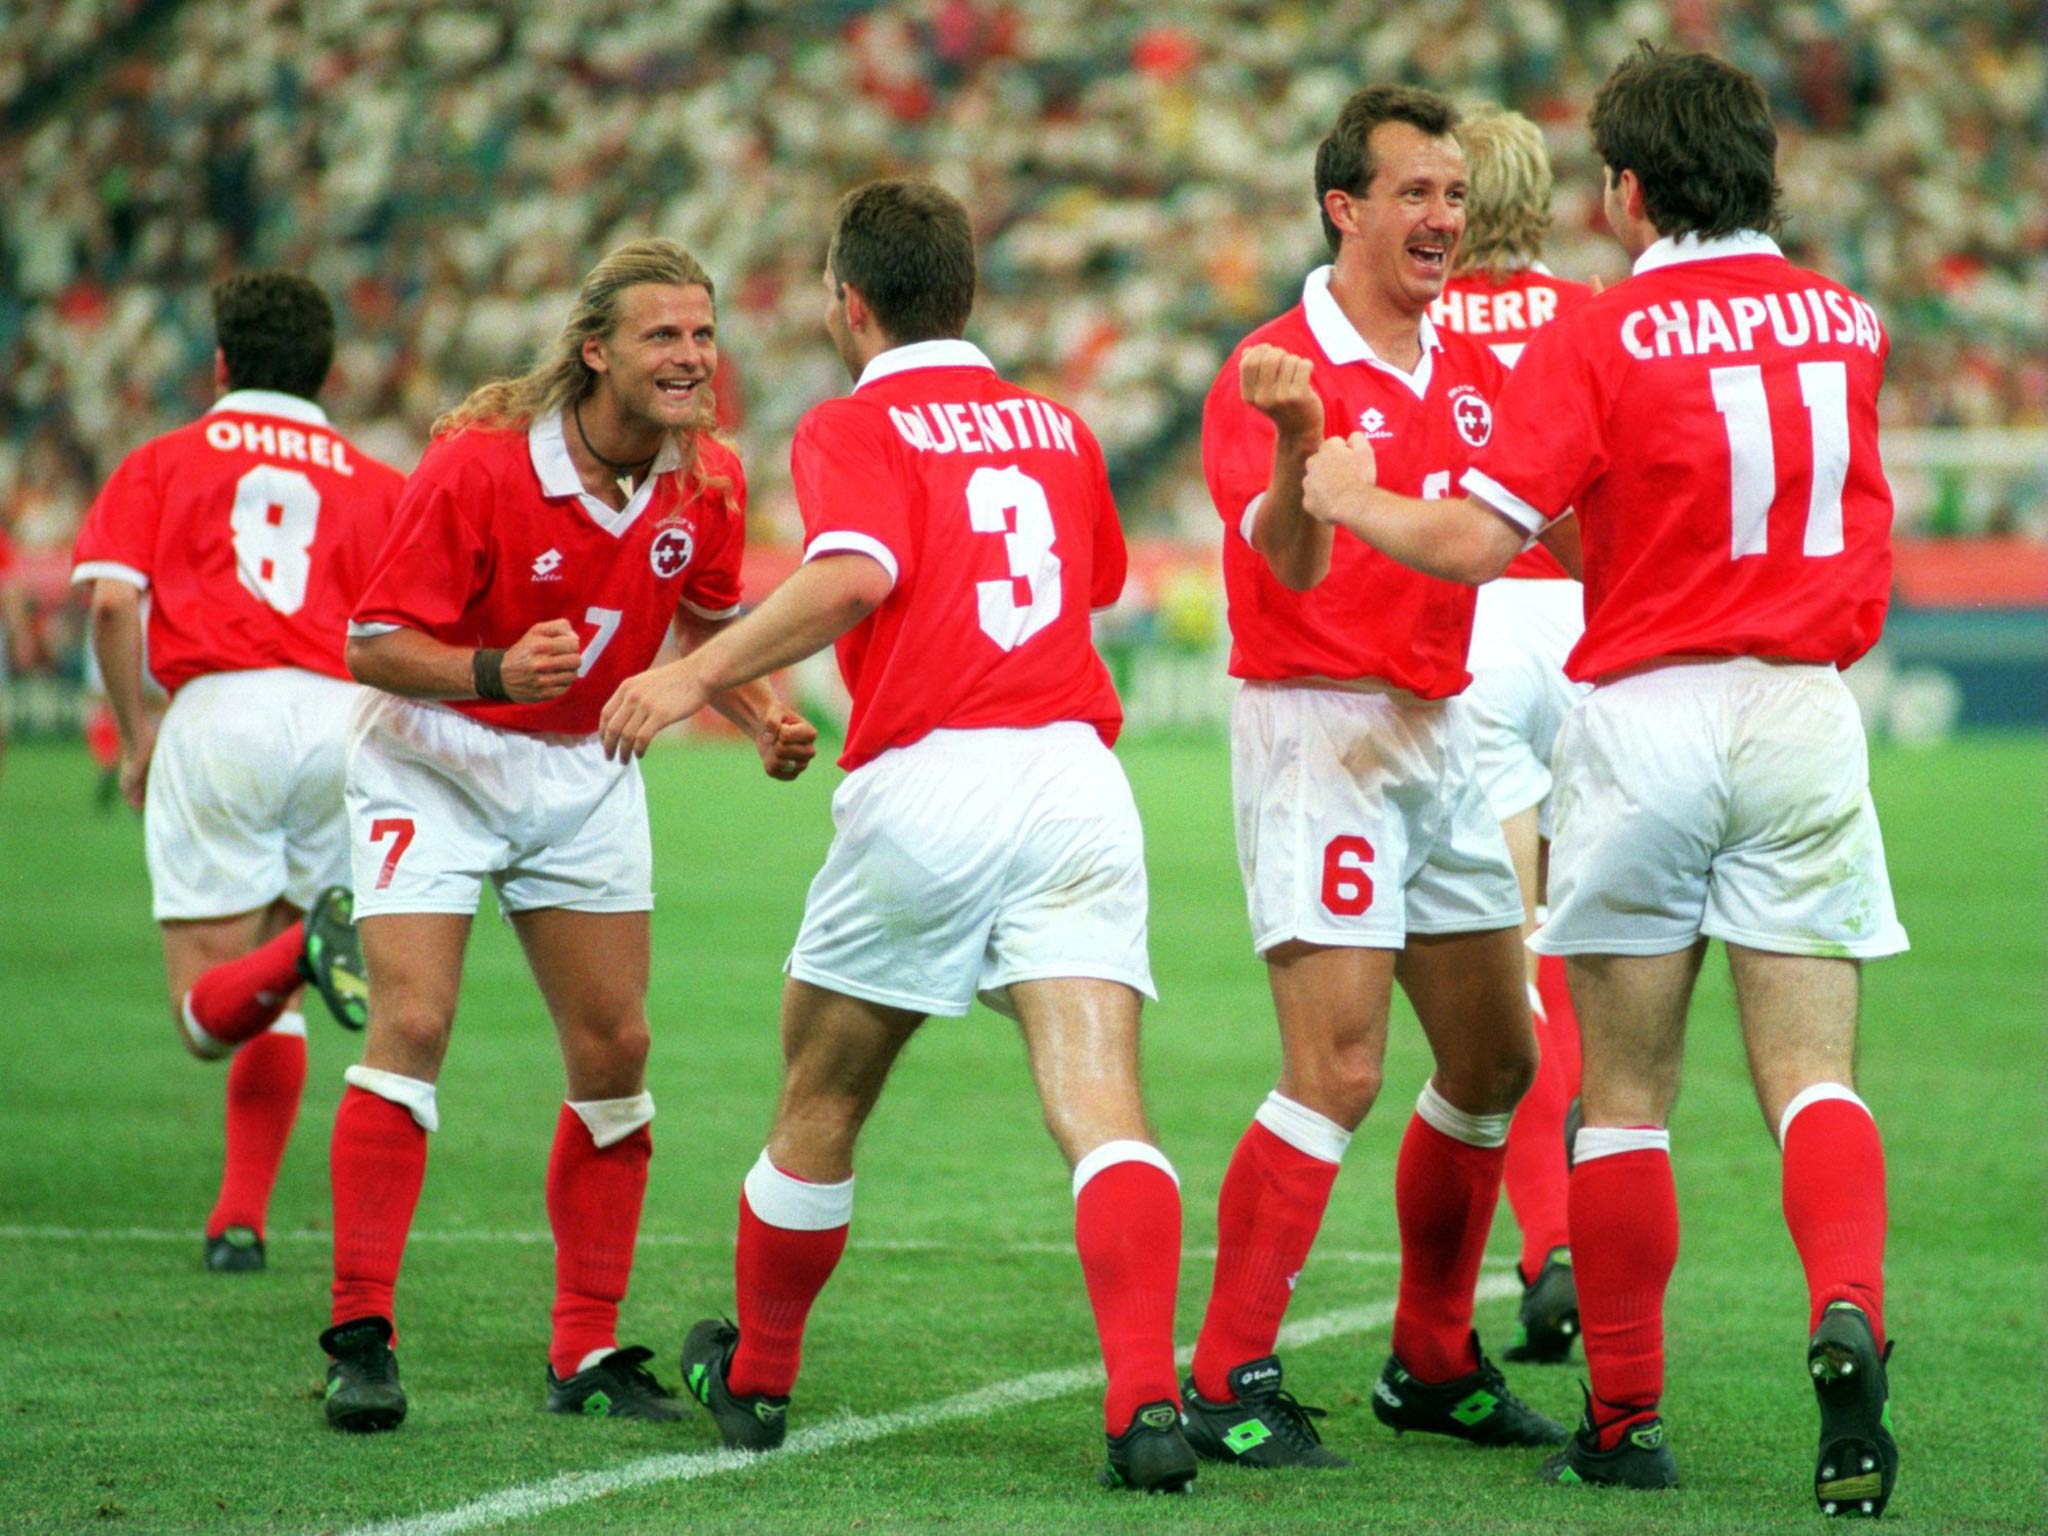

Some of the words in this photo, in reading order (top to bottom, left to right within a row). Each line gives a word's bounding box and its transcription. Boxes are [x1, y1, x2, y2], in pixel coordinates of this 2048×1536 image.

[1430, 286, 1557, 334] HERR
[206, 420, 354, 477] OHREL
[888, 398, 1079, 457] QUENTIN
[1709, 361, 1850, 561] 11
[230, 463, 321, 617] 8
[965, 464, 1062, 653] 3
[577, 606, 623, 678] 7
[369, 818, 416, 890] 7
[1321, 834, 1375, 916] 6
